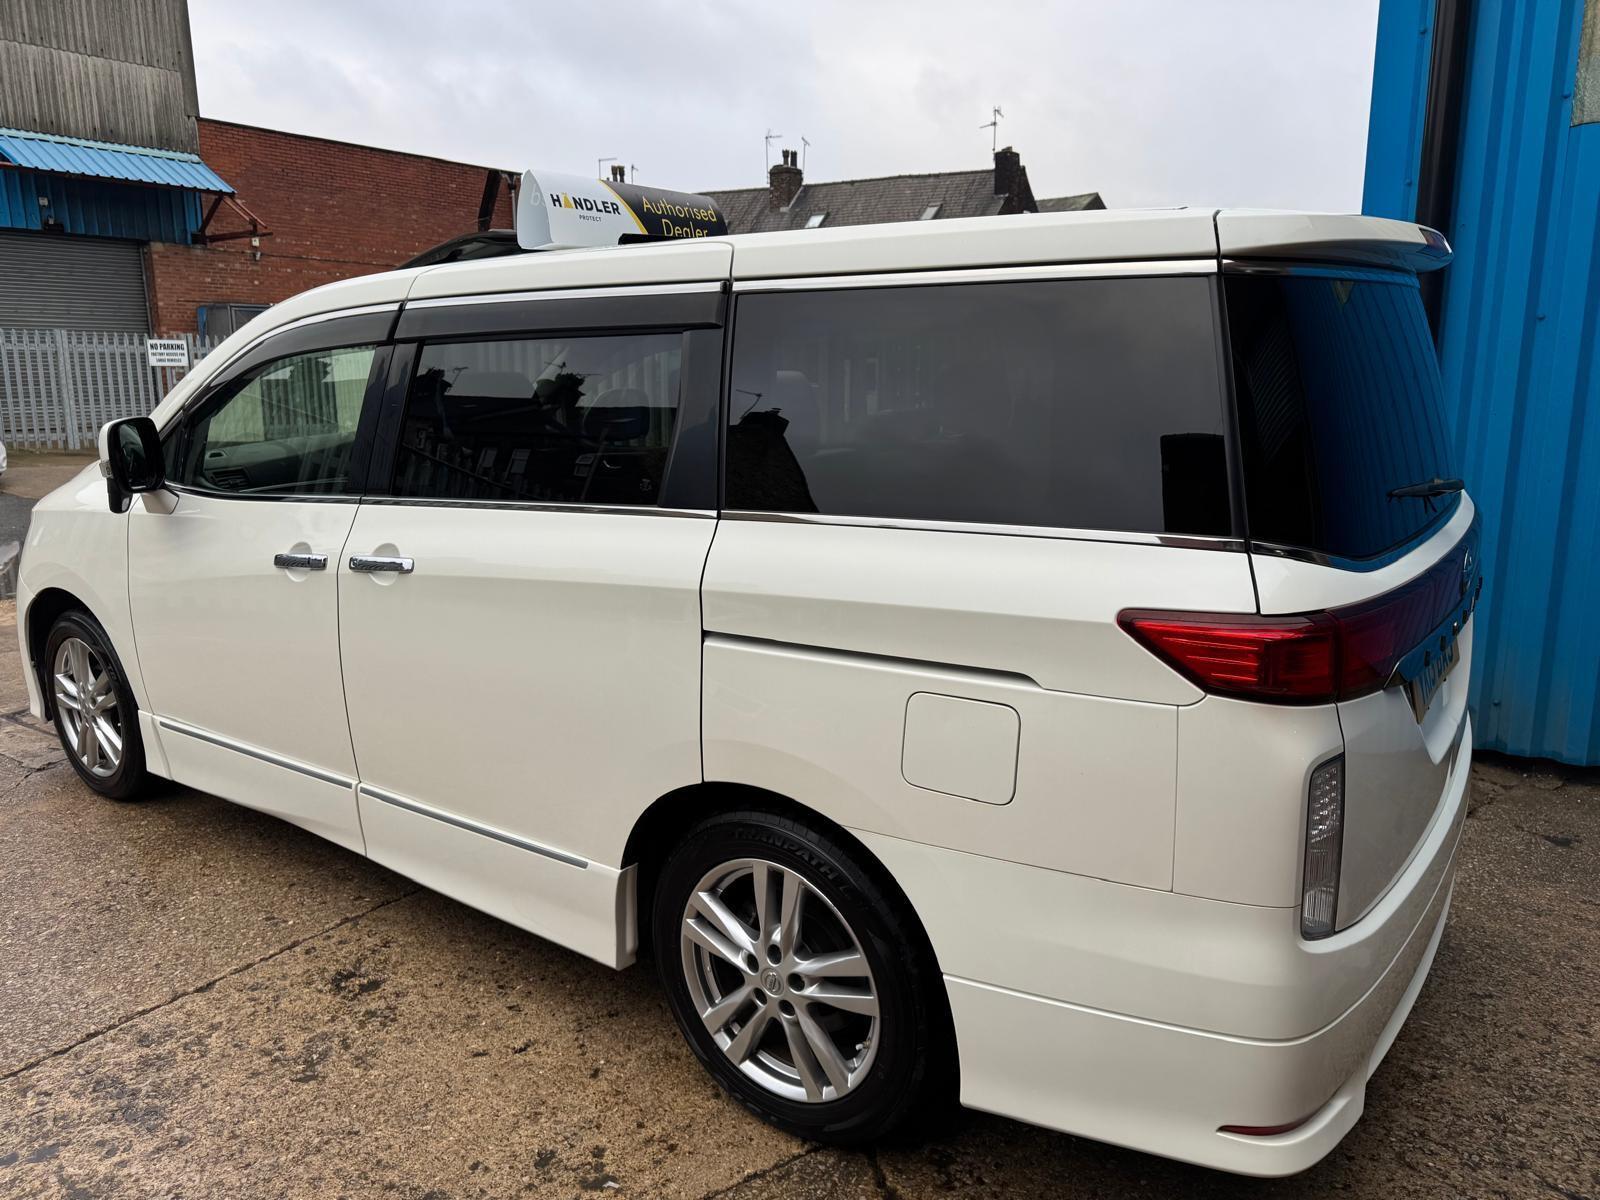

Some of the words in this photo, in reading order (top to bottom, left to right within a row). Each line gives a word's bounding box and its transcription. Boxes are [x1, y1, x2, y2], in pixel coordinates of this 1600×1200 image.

[579, 214, 601, 222] PROTECT
[642, 196, 717, 222] Authorised
[662, 219, 708, 238] Dealer
